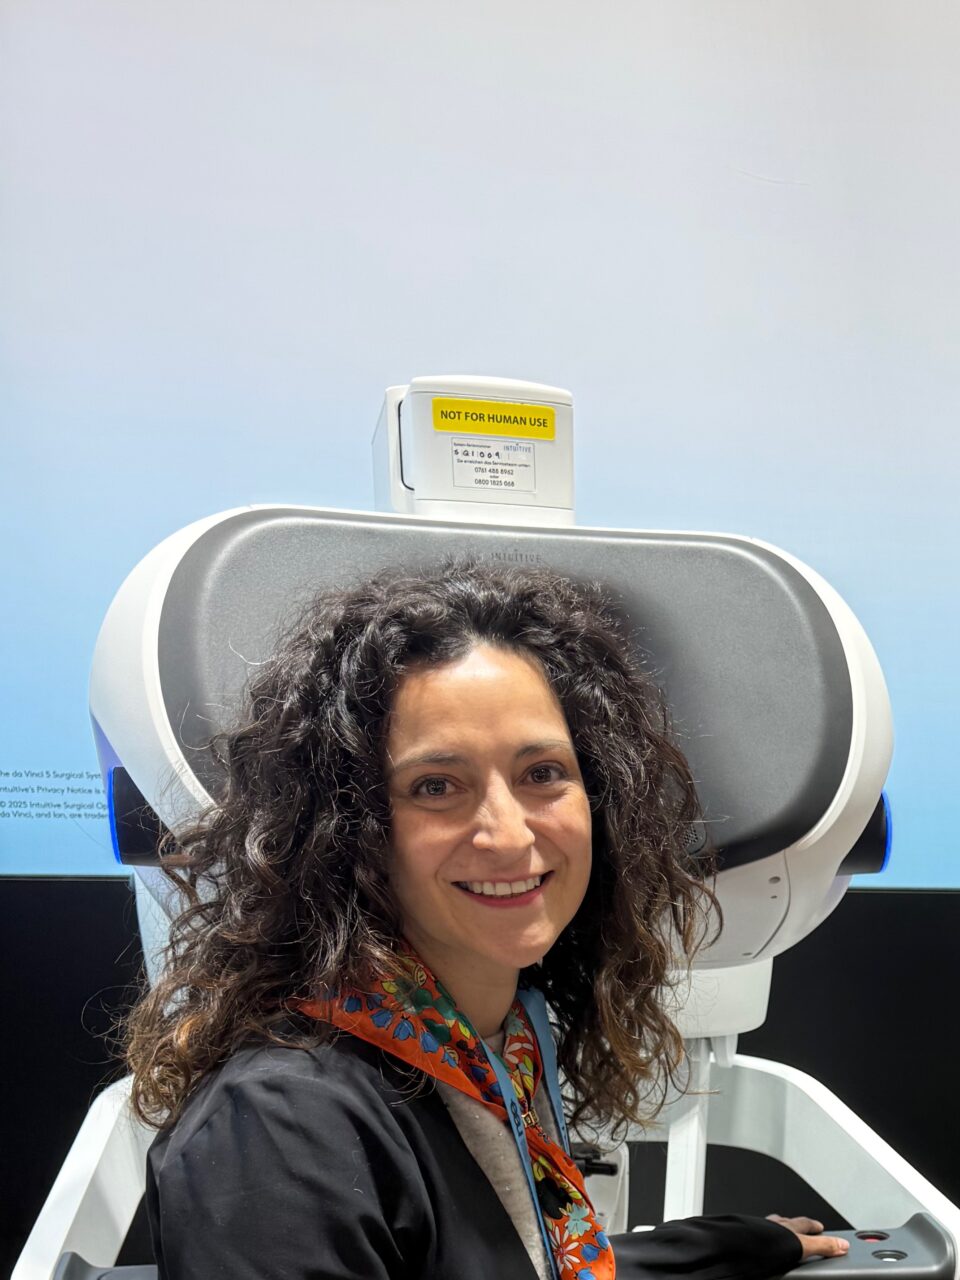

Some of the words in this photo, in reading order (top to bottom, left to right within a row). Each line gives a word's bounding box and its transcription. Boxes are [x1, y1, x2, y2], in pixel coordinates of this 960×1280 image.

[440, 410, 462, 421] NOT
[464, 412, 485, 423] FOR
[487, 414, 527, 427] HUMAN
[529, 417, 549, 428] USE
[504, 443, 532, 453] INTUITIVE
[475, 478, 489, 486] 0800
[24, 770, 44, 778] Vinci
[53, 771, 84, 780] Surgical
[37, 786, 65, 795] Privacy
[64, 802, 95, 811] Surgical
[12, 811, 34, 819] Vinci,
